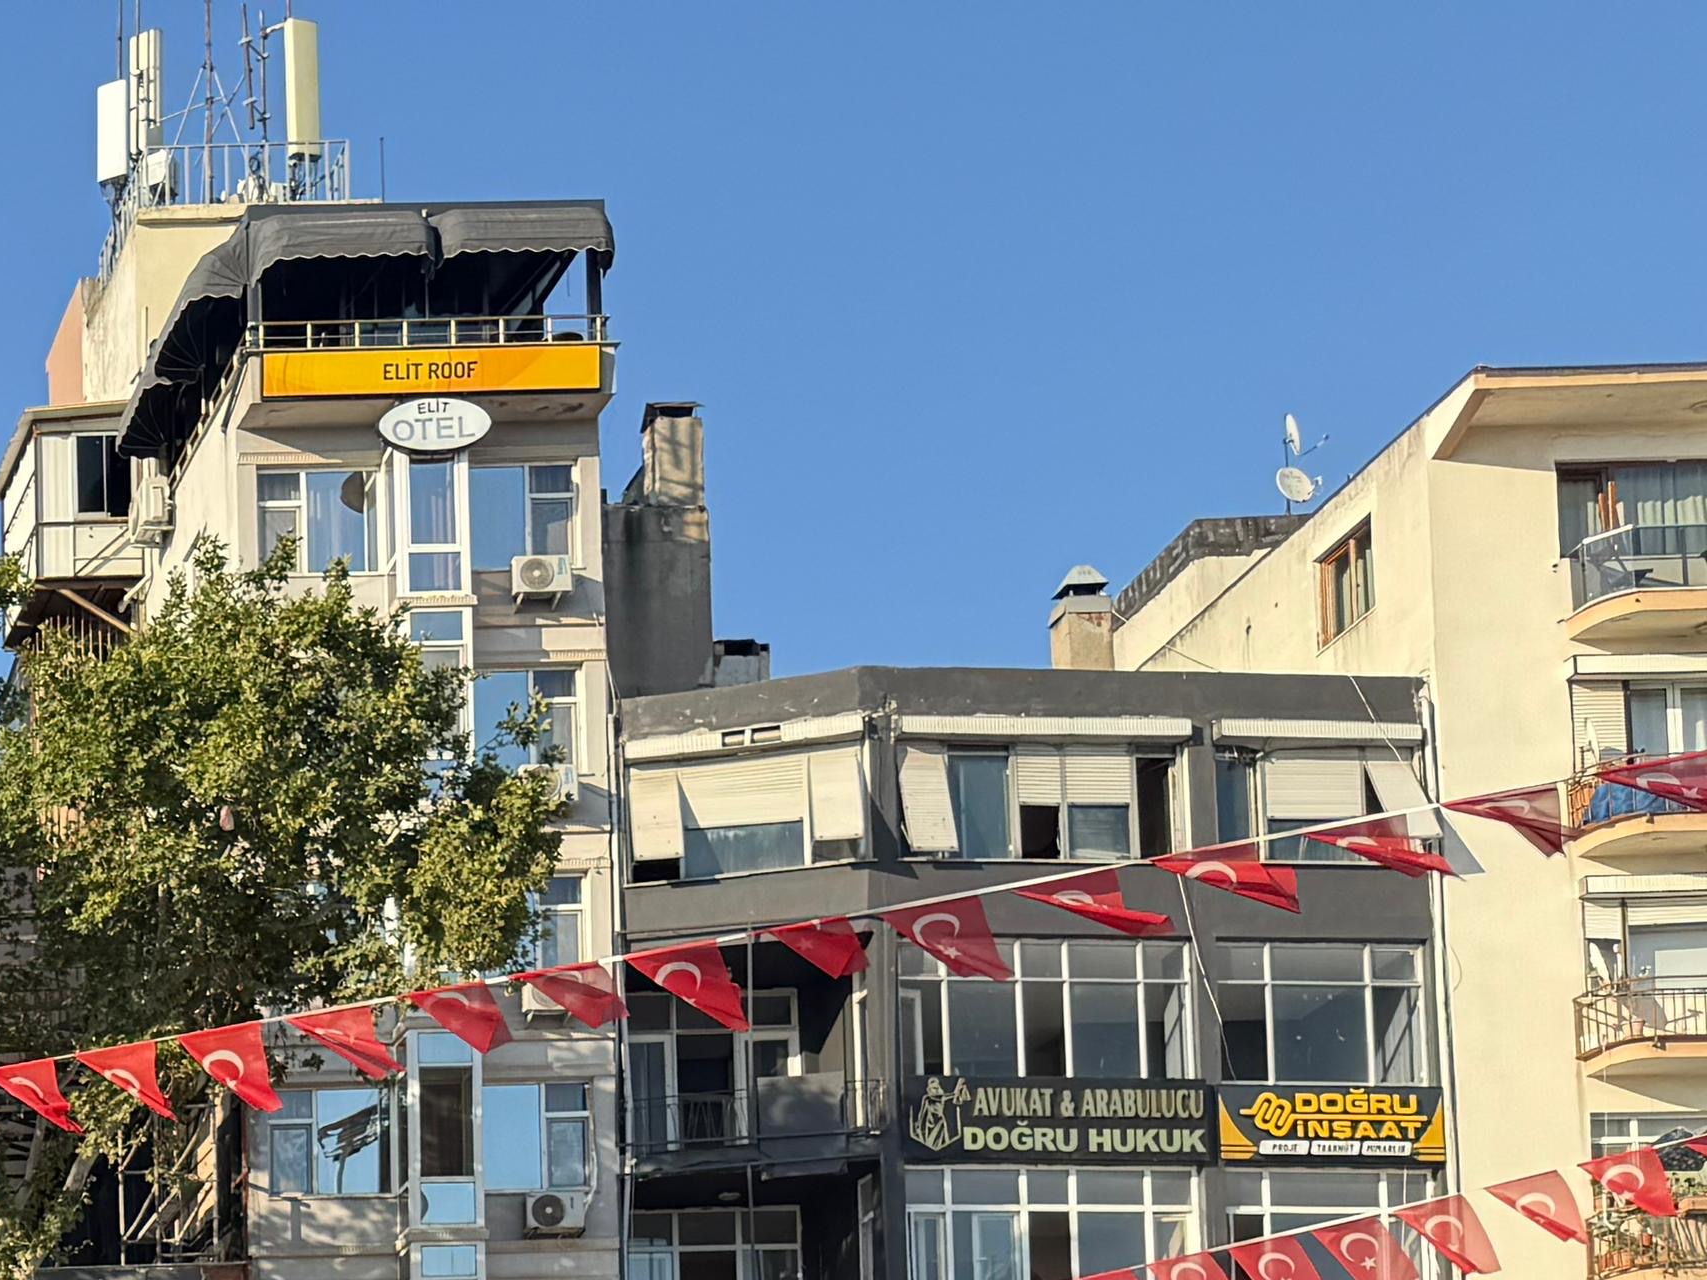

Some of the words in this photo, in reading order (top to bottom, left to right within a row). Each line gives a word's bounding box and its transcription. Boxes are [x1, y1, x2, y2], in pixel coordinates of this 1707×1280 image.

[383, 358, 423, 380] ELİT
[428, 361, 478, 379] ROOF
[417, 399, 450, 414] ELİT
[392, 416, 475, 441] OTEL
[973, 1088, 1054, 1116] AVUKAT
[1060, 1088, 1075, 1117] &
[1081, 1088, 1204, 1119] ARABULUCU
[1295, 1088, 1417, 1114] DOĞRU
[963, 1120, 1078, 1151] DOĞRU
[1089, 1128, 1207, 1153] HUKUK
